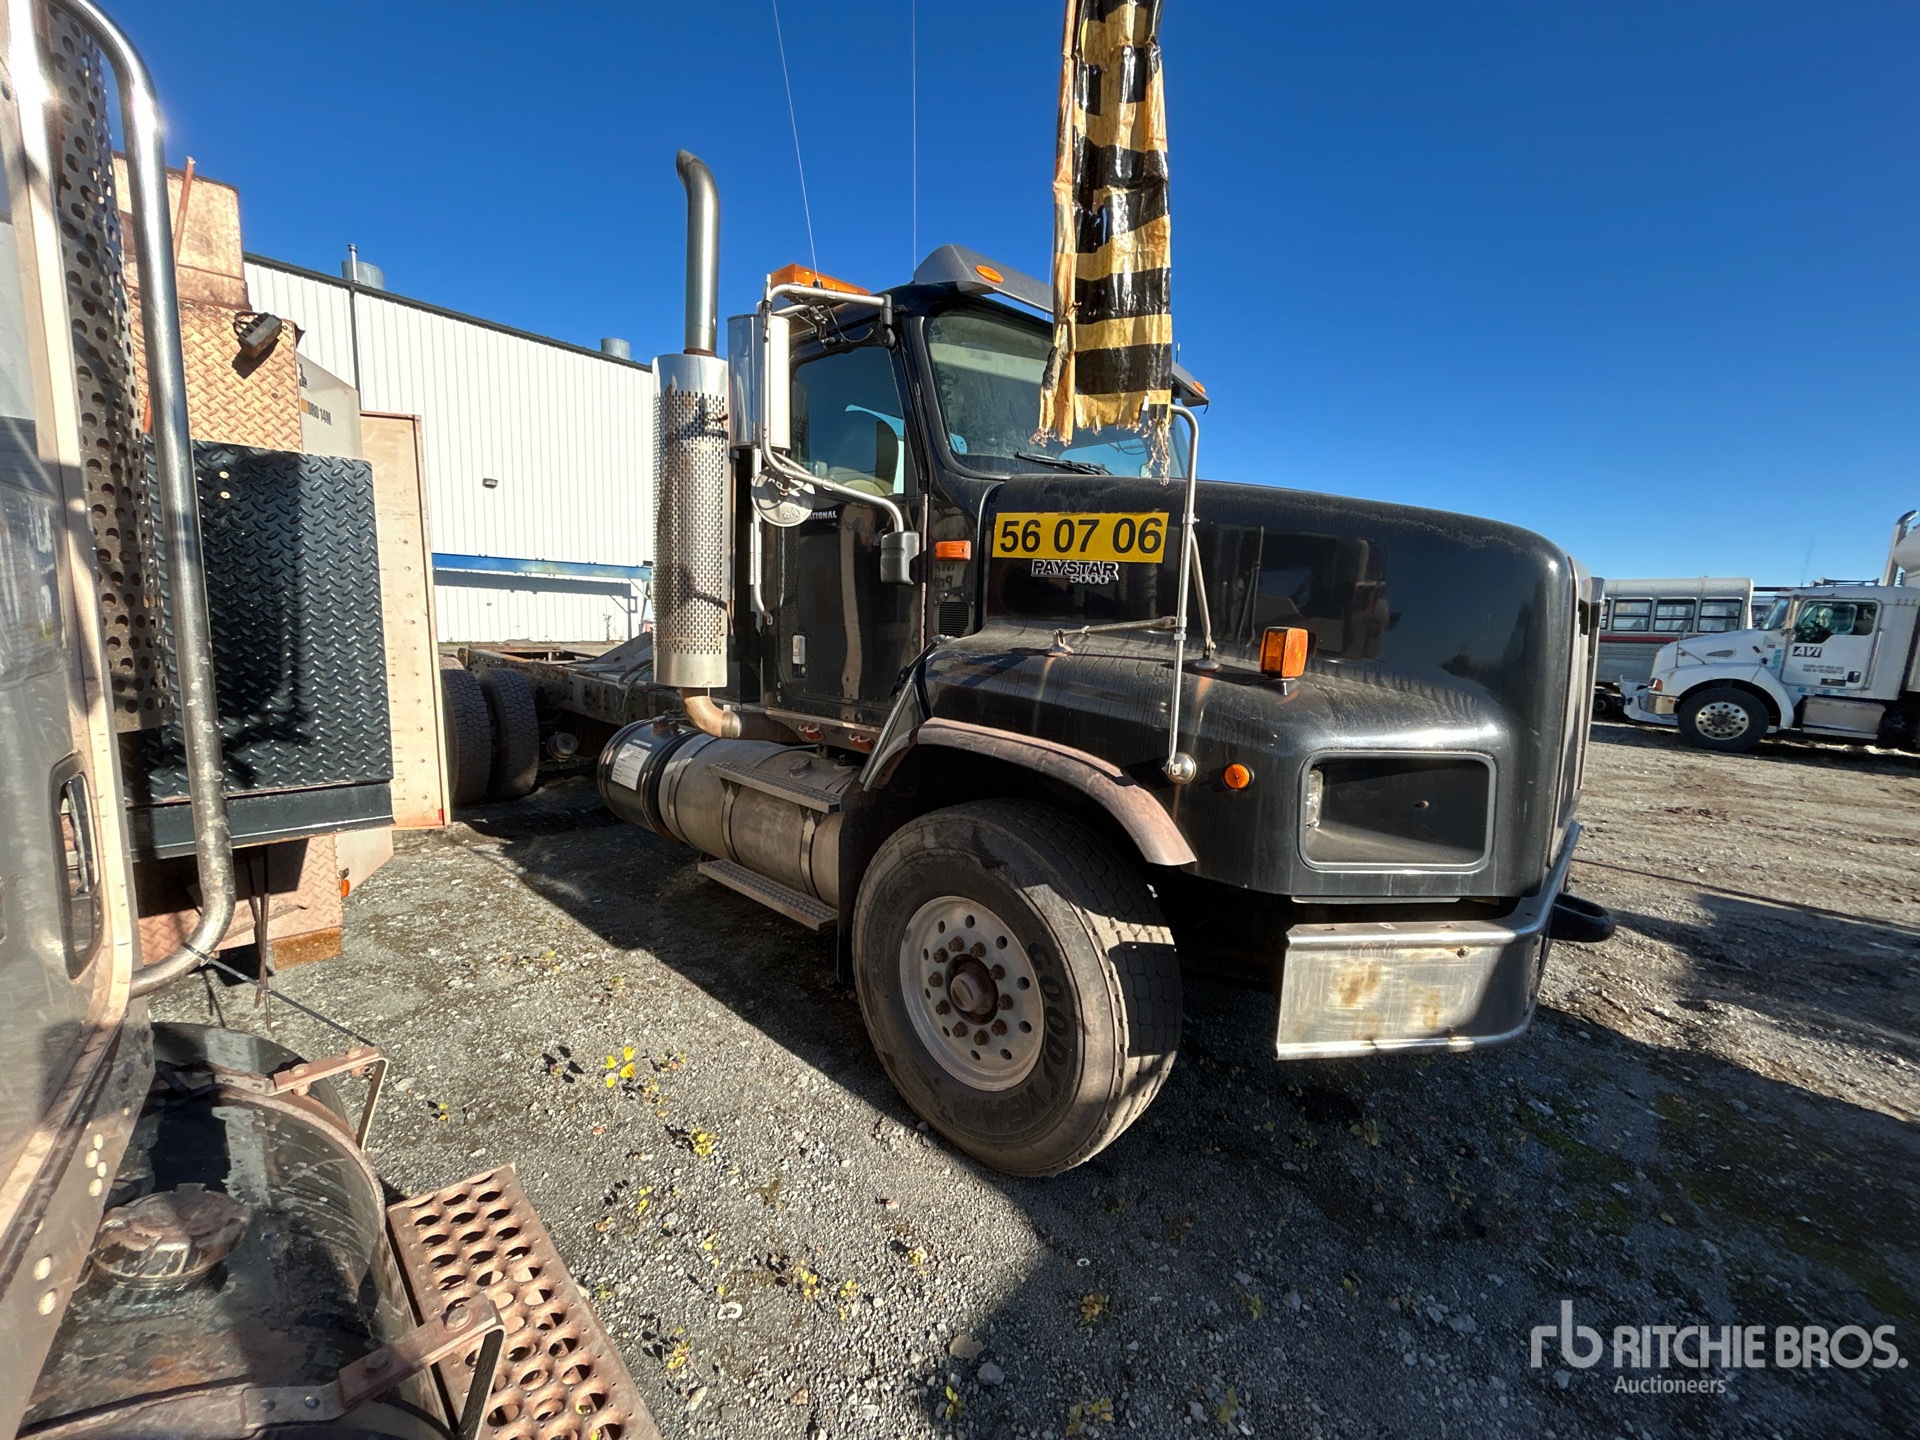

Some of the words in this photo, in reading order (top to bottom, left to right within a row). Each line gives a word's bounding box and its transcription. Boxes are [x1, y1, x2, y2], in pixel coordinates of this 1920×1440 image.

[1000, 520, 1041, 552] 56
[1054, 519, 1100, 553] 07
[1112, 517, 1163, 553] 06
[1031, 559, 1119, 580] PAYSTAR
[1069, 574, 1109, 585] 5000
[1794, 647, 1820, 658] AVI
